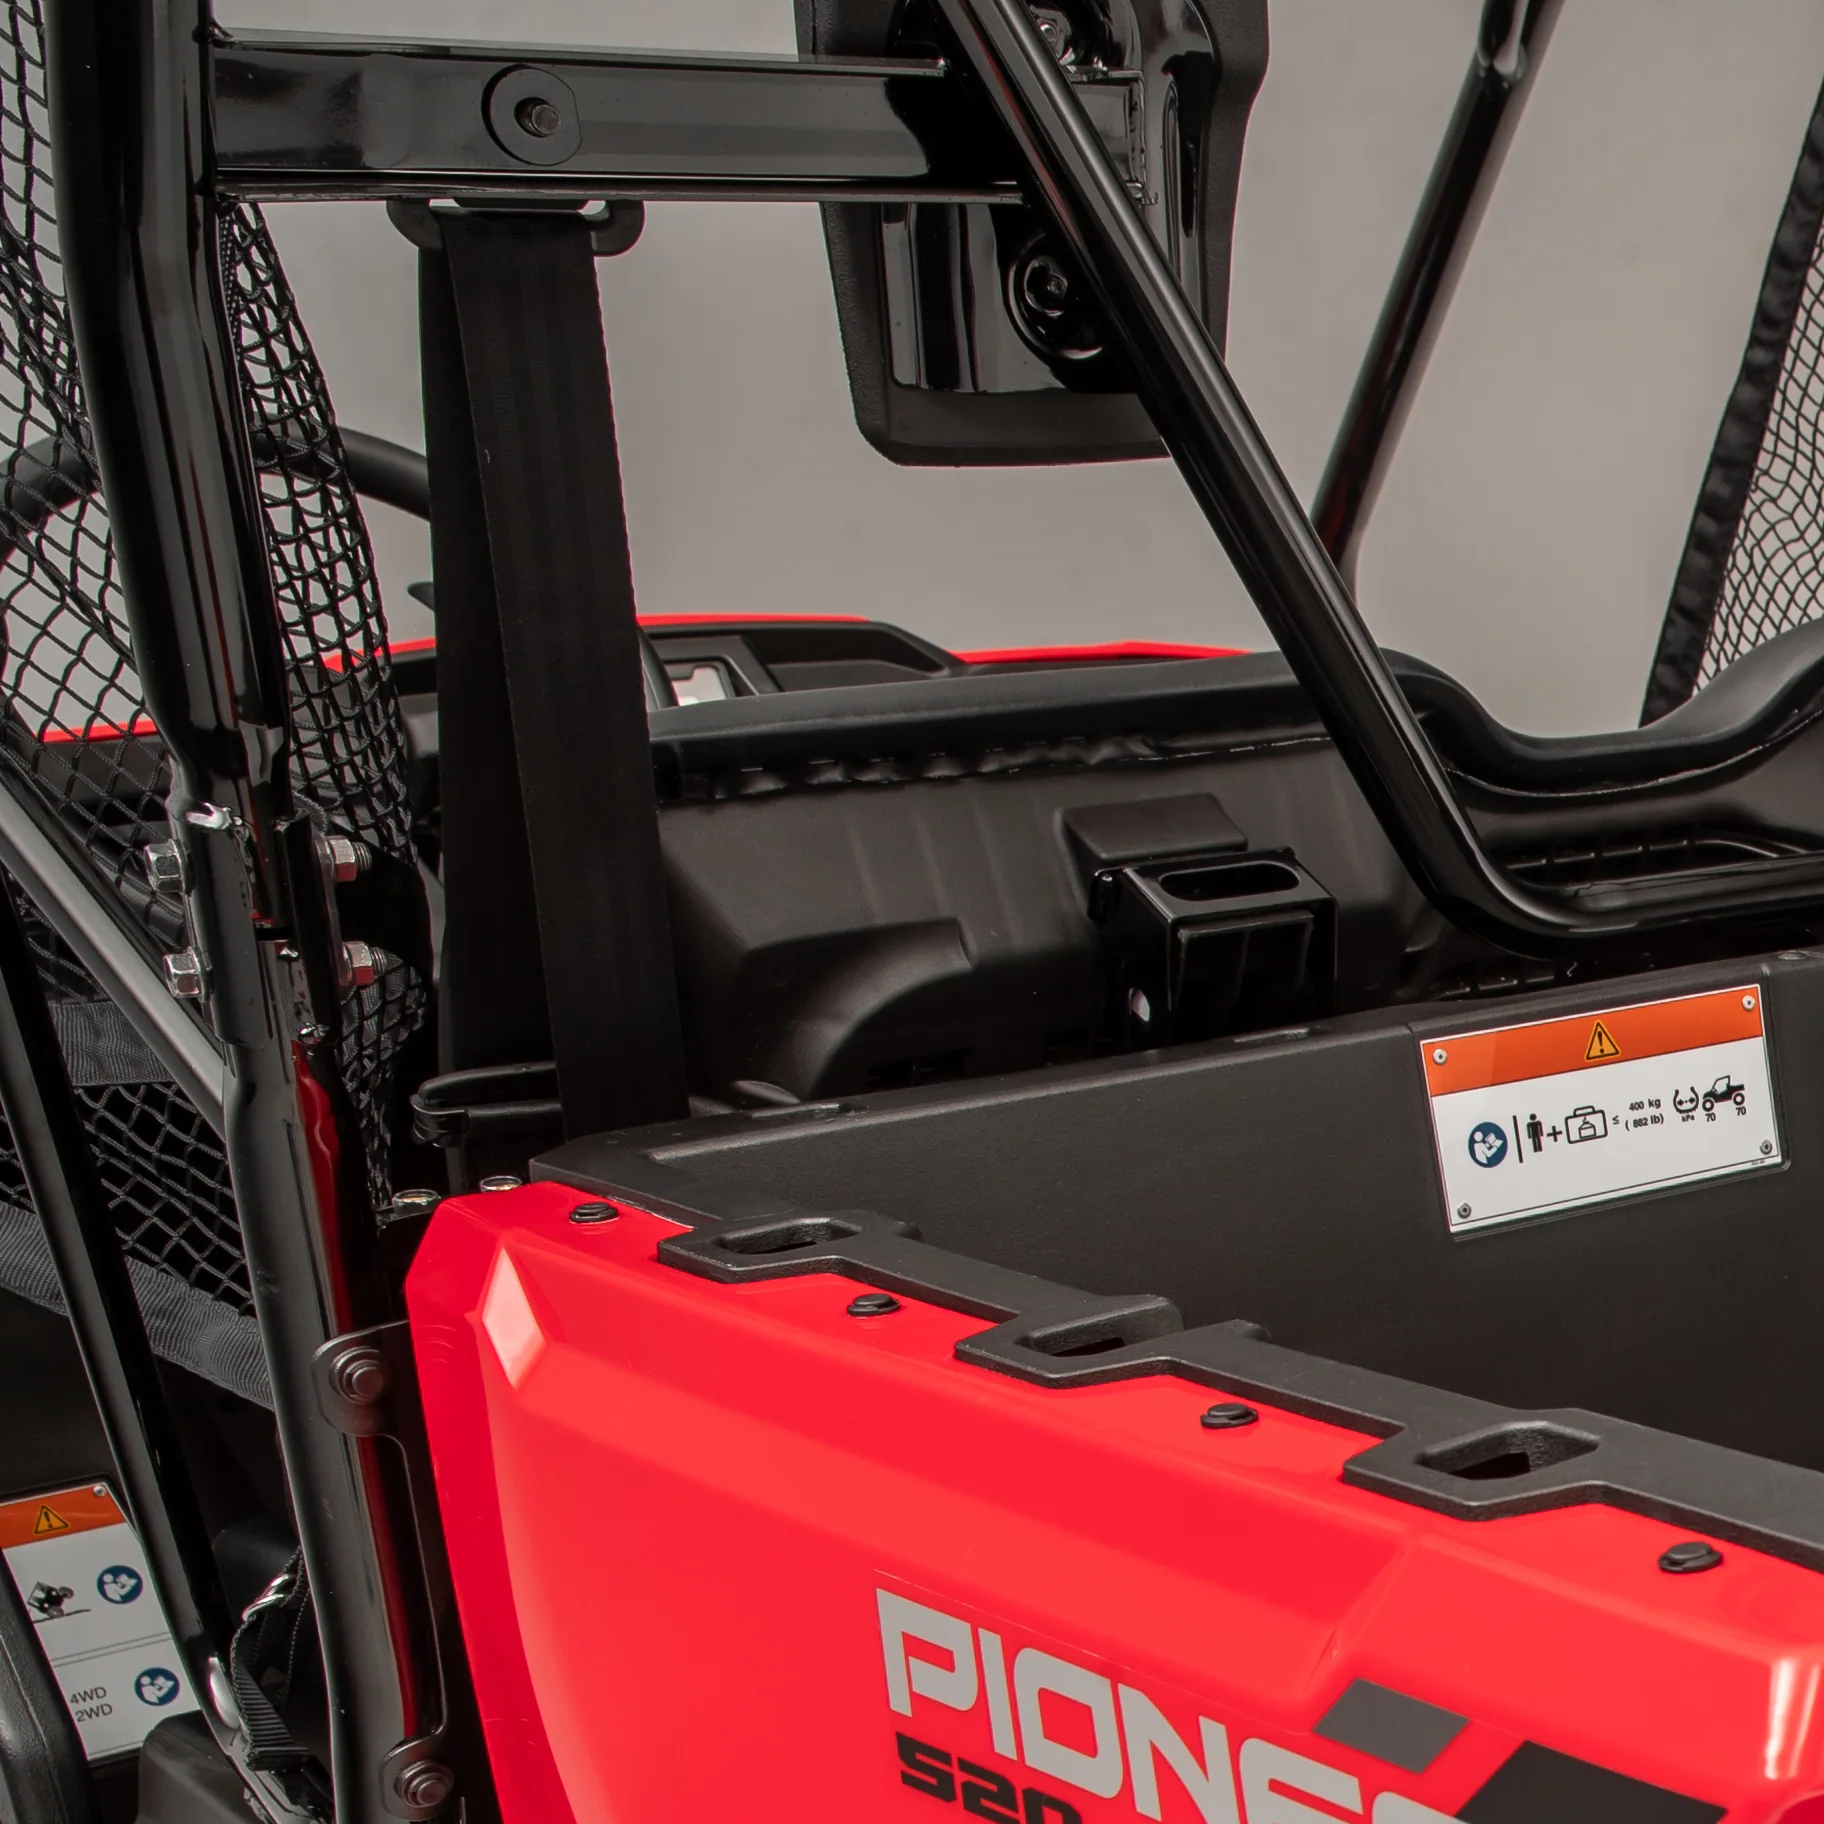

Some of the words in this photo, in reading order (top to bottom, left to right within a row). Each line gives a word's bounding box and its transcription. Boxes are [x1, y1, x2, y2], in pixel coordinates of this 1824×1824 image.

[1629, 1101, 1645, 1111] 400
[1648, 1098, 1661, 1109] kg
[1736, 1106, 1747, 1116] 70
[1705, 1112, 1716, 1122] 70
[70, 1686, 107, 1704] 4WD
[75, 1703, 113, 1722] 2WD
